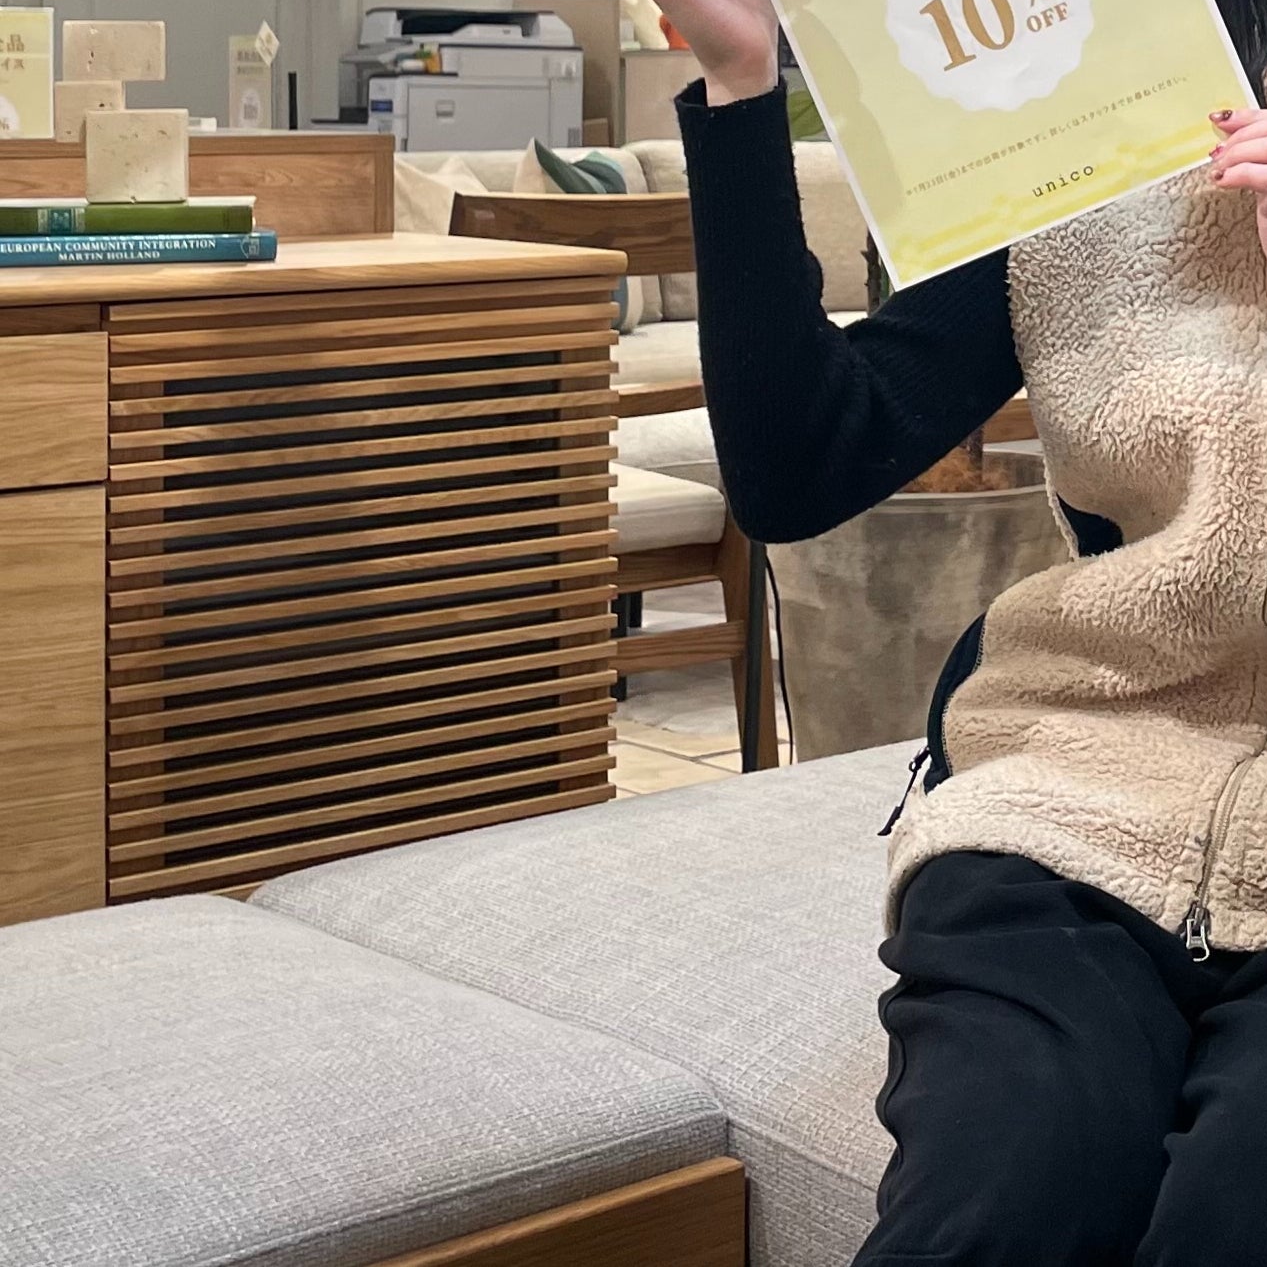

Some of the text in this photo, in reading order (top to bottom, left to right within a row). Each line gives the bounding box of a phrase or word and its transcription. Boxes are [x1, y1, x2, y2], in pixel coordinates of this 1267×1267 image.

[1026, 1, 1069, 33] OFF
[1032, 165, 1095, 198] unico
[0, 238, 217, 253] EUROPEAN COMMUNITY INTEGRATION
[58, 250, 161, 261] MARTIN HOLLAND
